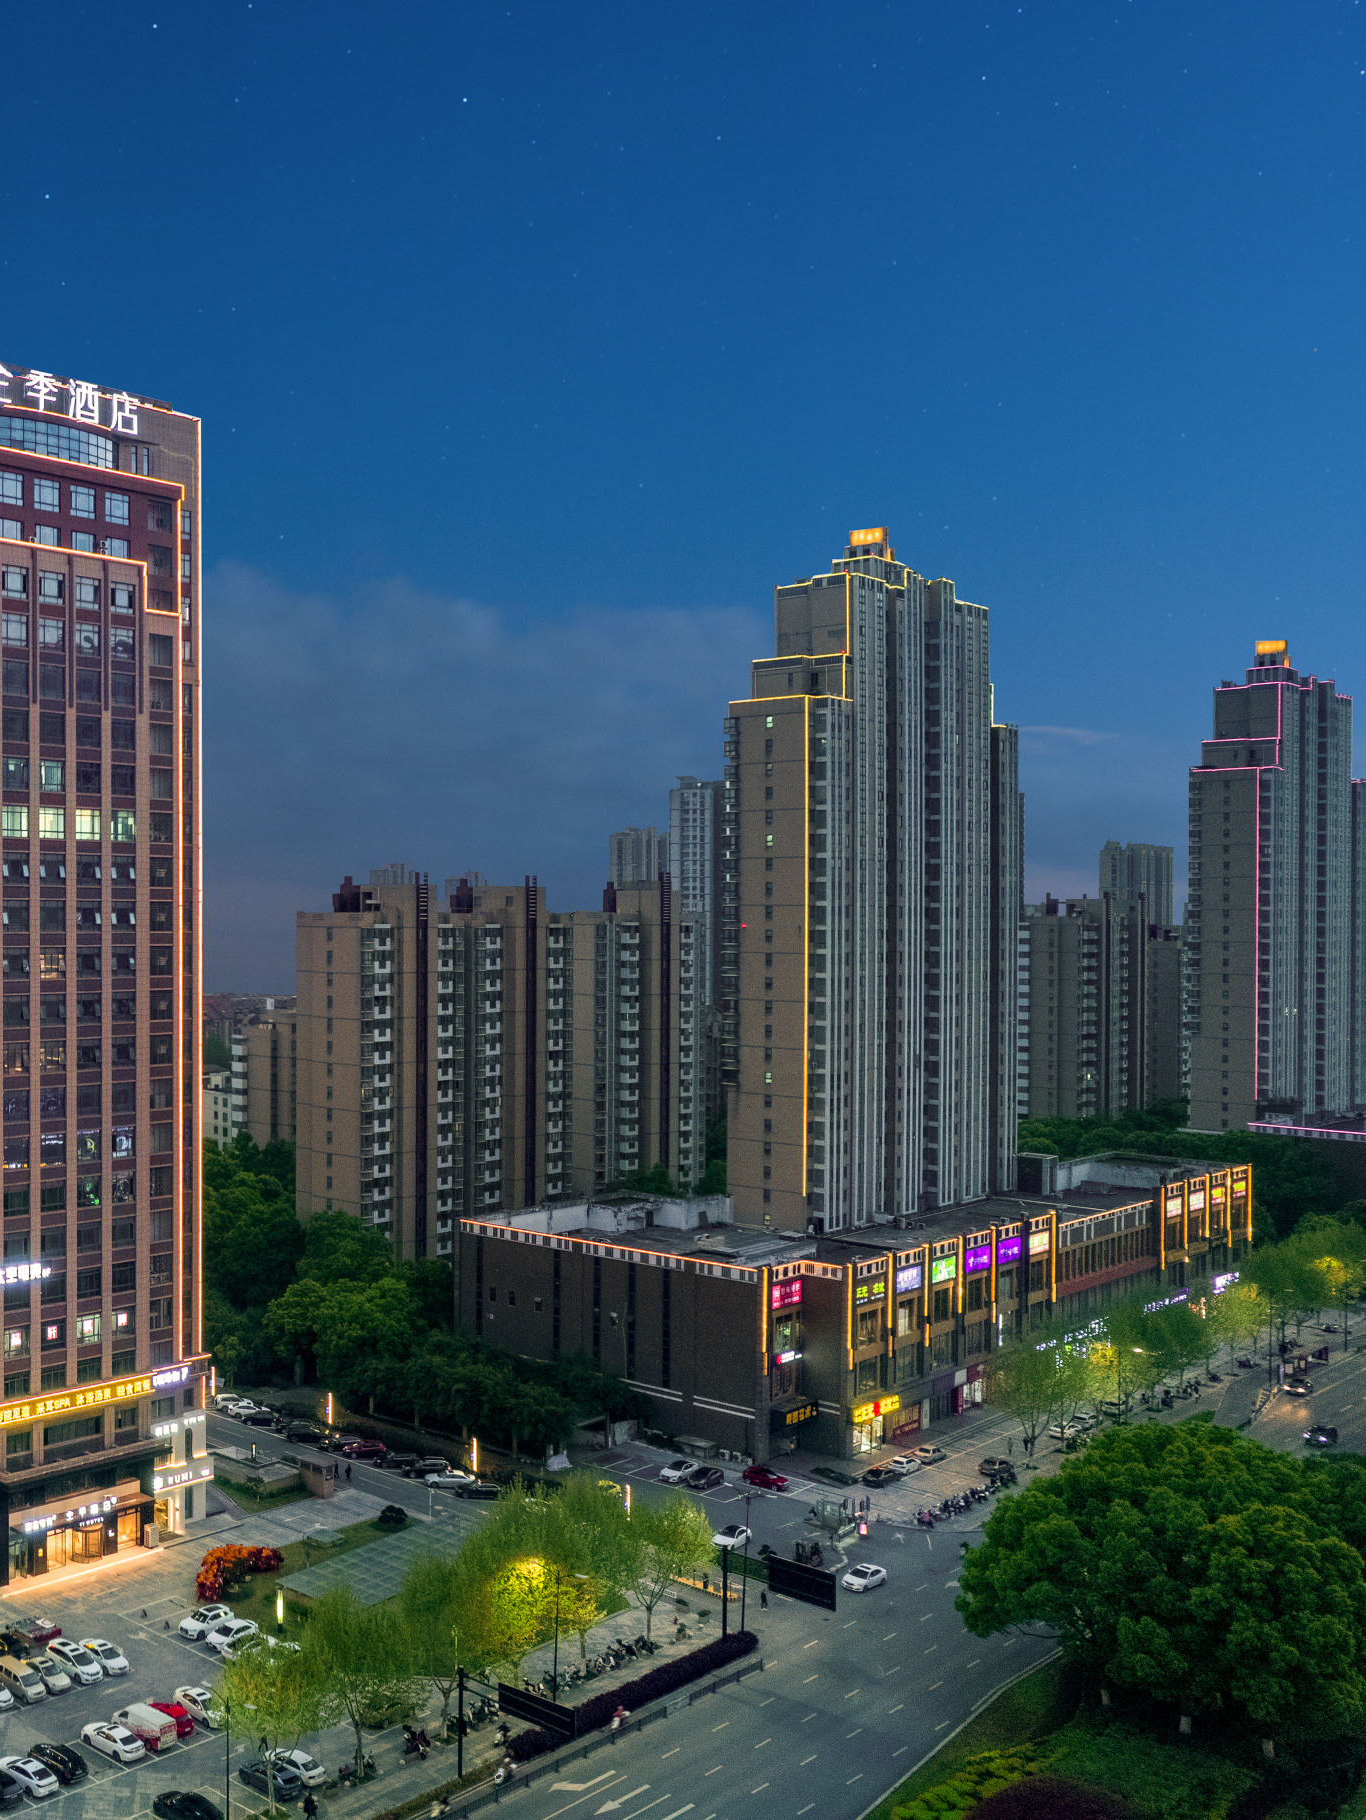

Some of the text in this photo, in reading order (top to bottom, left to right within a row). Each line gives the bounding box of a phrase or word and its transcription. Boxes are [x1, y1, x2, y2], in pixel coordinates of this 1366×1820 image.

[36, 1397, 71, 1415] 采耳SPA
[76, 1388, 112, 1406] 沐浴汤泉
